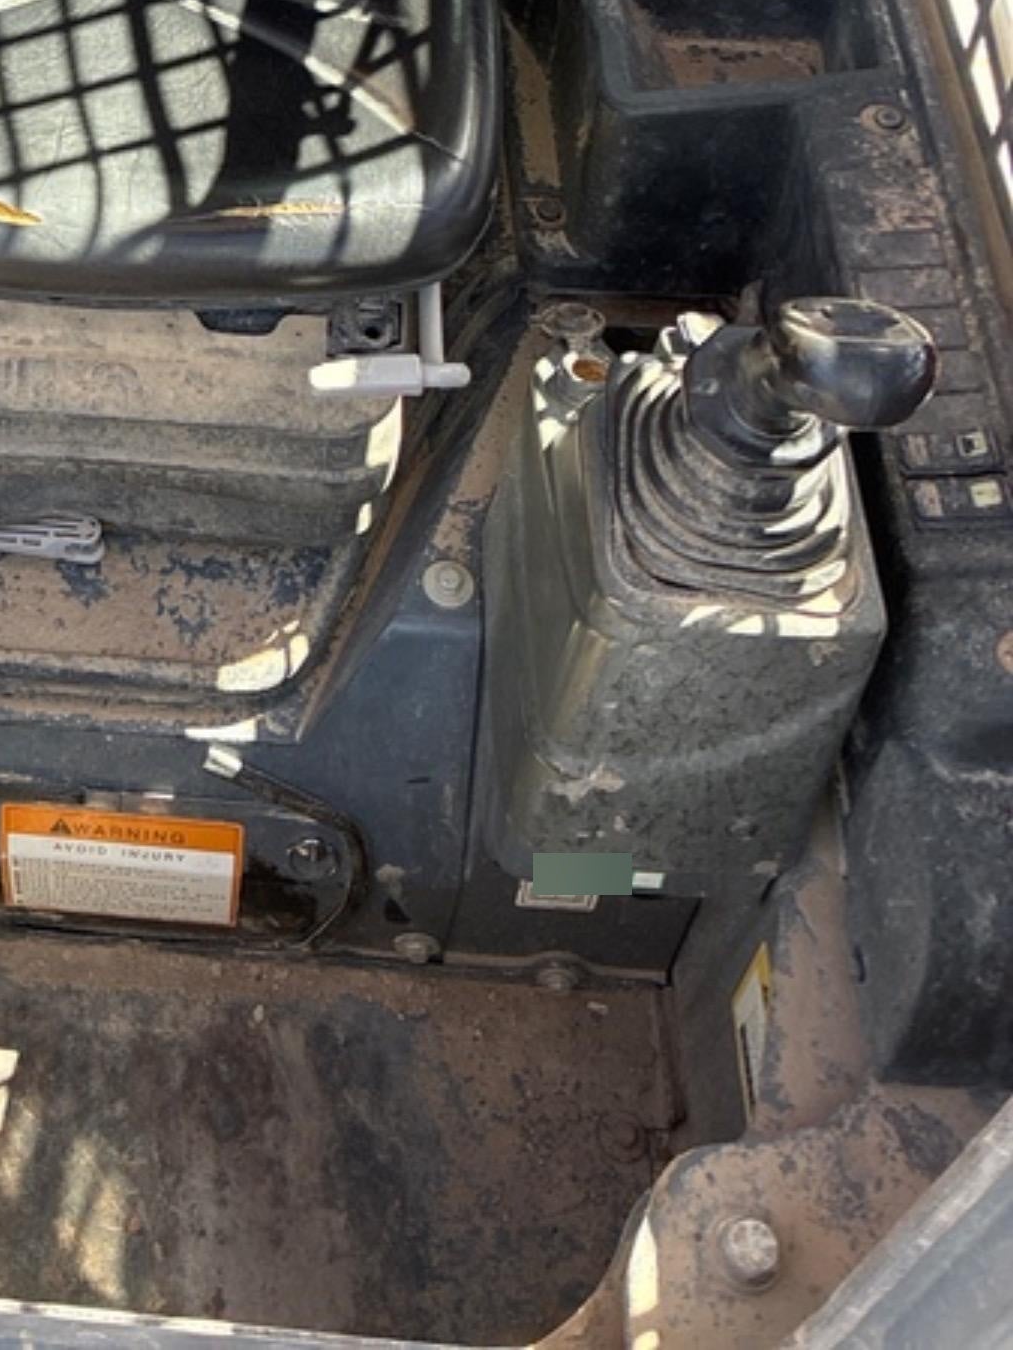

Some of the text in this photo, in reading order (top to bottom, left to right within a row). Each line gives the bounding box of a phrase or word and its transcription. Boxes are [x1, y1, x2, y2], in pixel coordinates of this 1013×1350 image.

[73, 822, 186, 844] WARNING
[53, 842, 185, 862] AVOID INJURY
